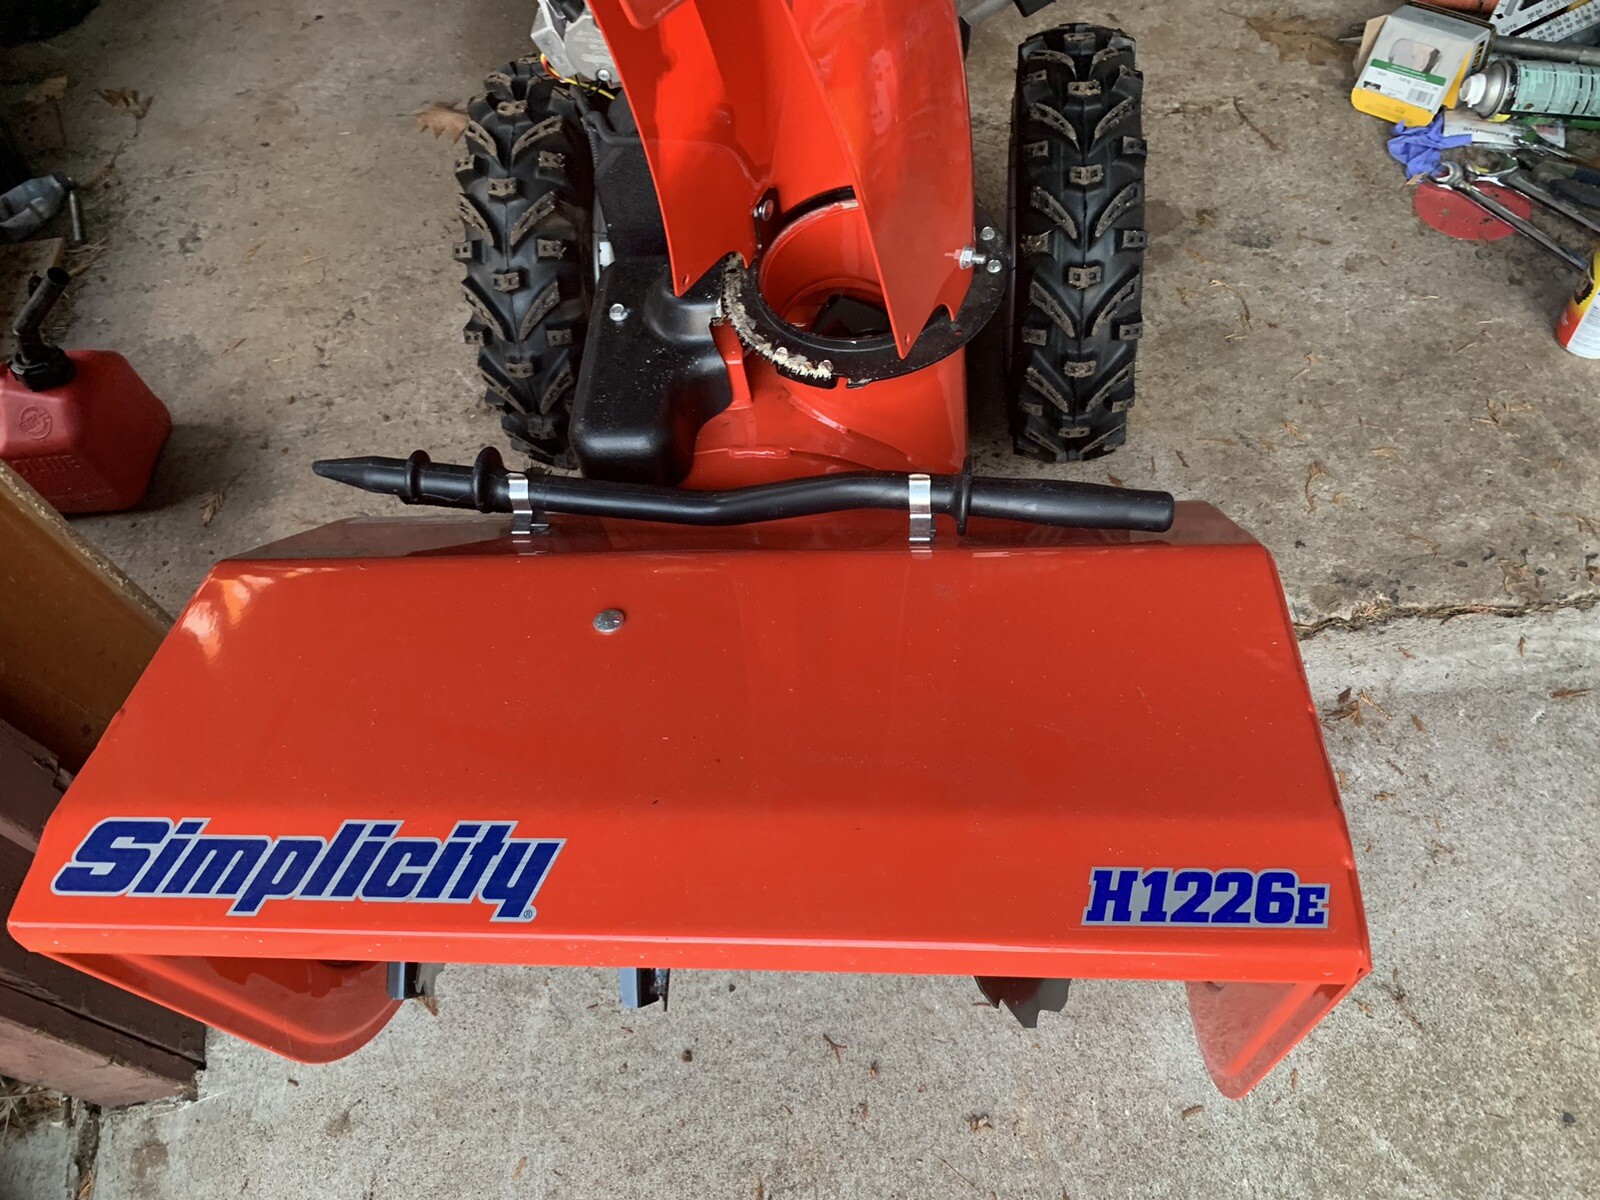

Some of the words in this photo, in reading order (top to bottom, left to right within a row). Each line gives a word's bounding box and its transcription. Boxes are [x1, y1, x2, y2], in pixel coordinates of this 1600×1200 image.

[1501, 23, 1518, 34] CUTS
[1463, 127, 1510, 138] Automotive
[52, 817, 566, 921] Simplicity
[1084, 868, 1328, 926] H1226E
